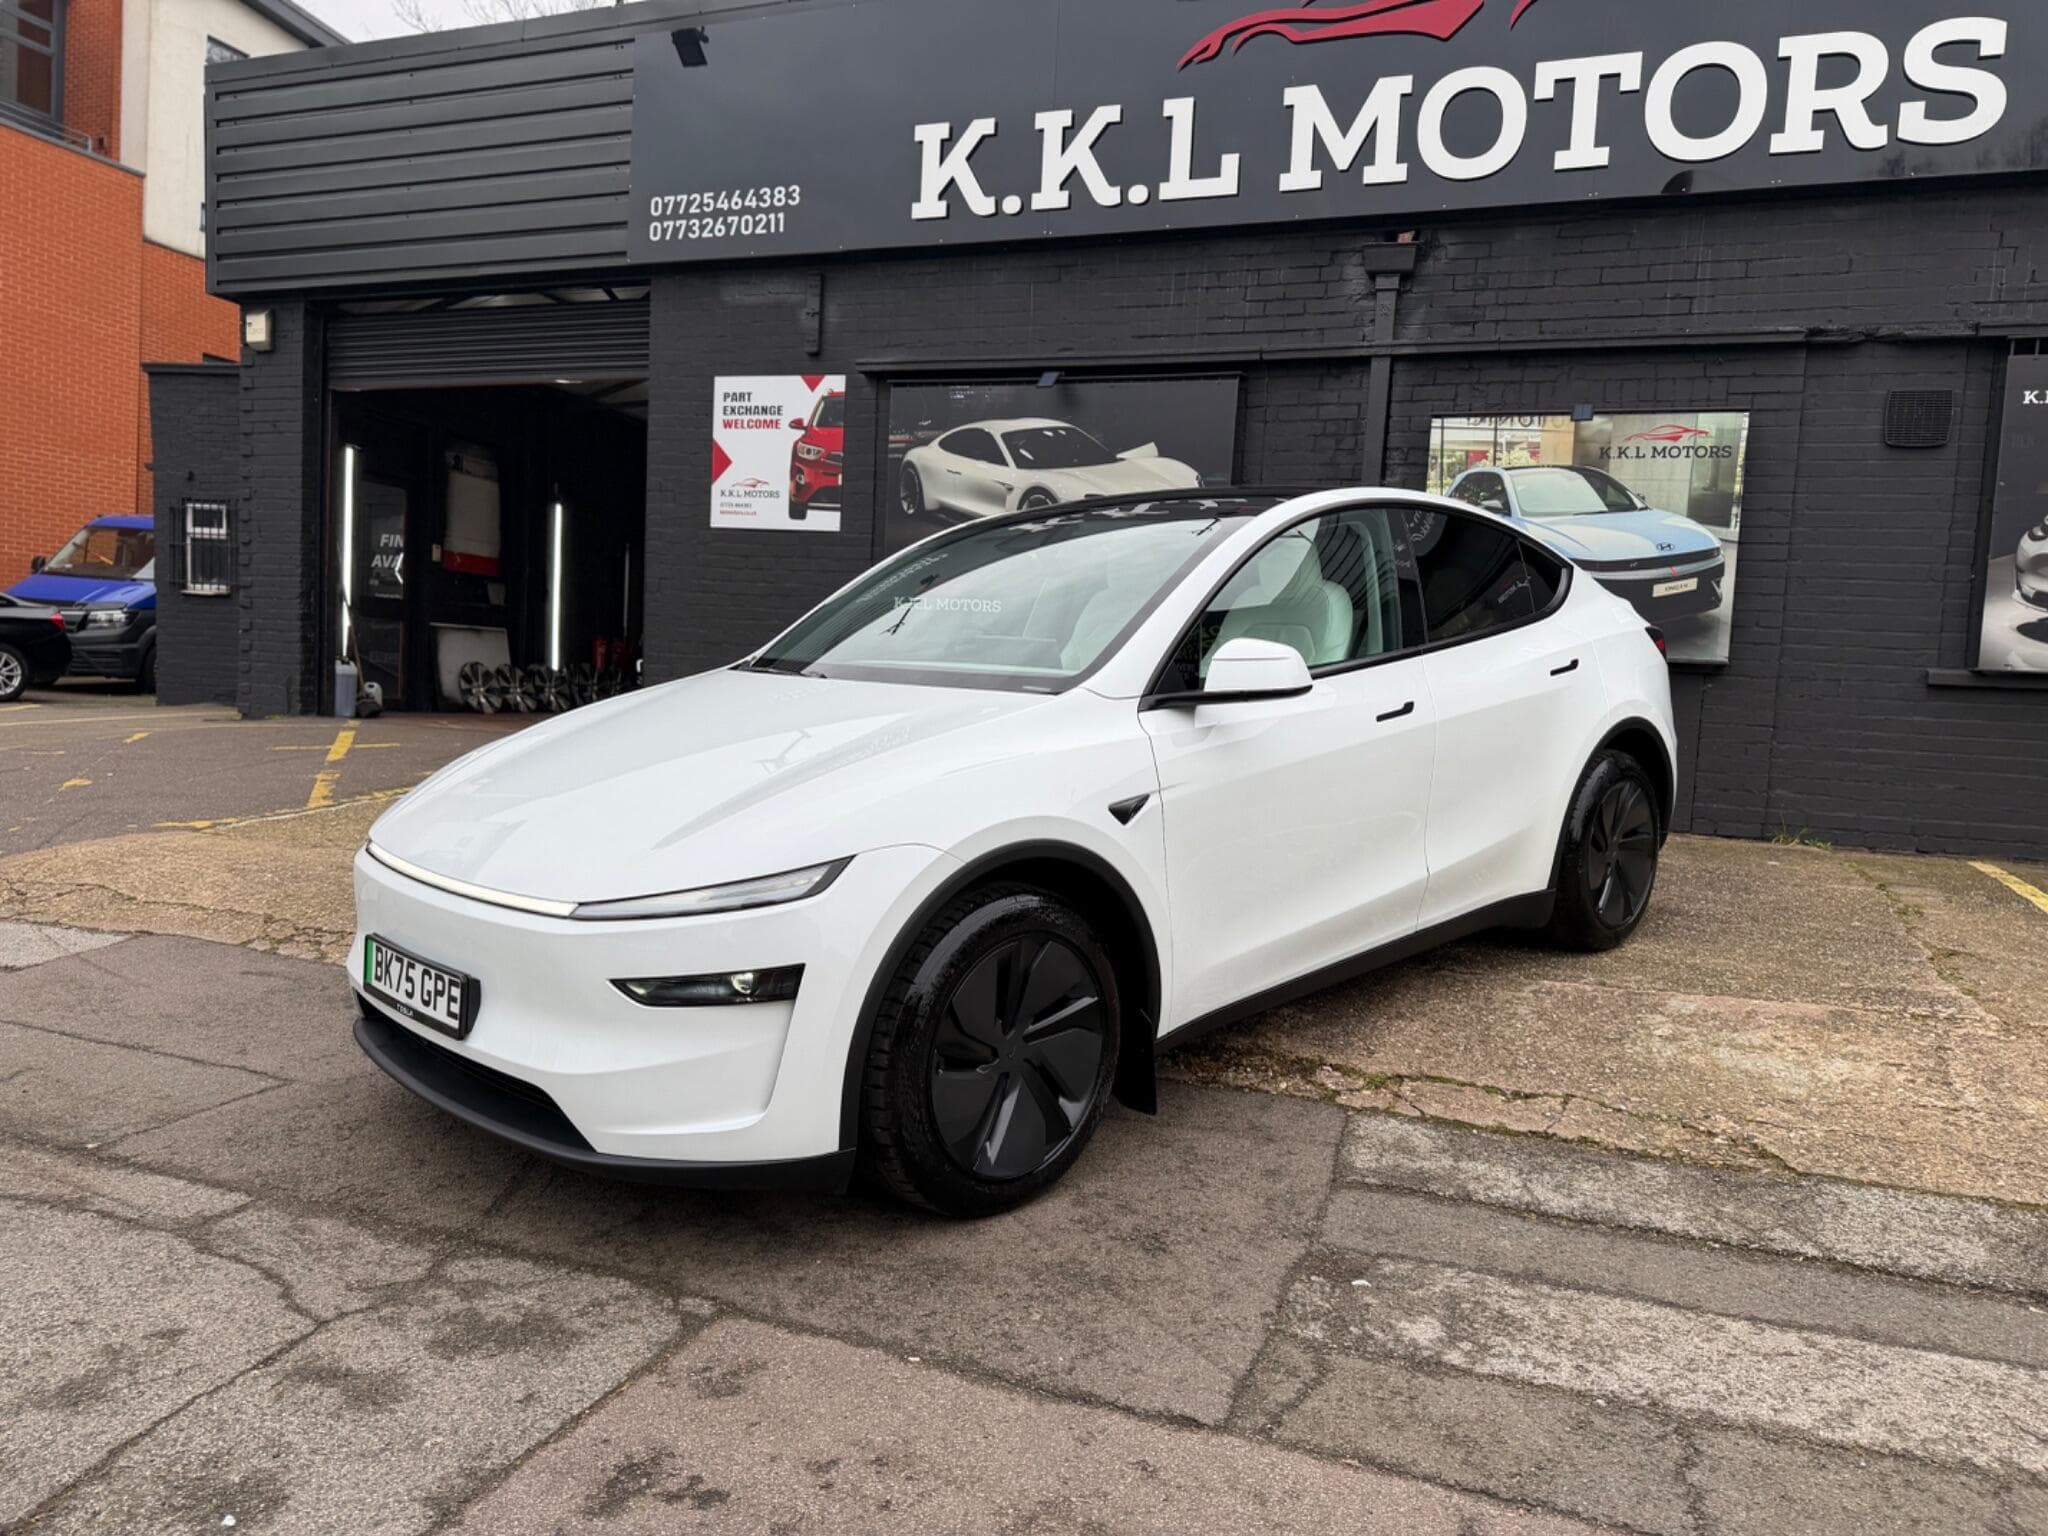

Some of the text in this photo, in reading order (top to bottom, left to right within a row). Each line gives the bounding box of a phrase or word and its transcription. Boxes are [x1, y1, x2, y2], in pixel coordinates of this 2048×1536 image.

[911, 16, 2008, 221] K.K.L MOTORS
[650, 185, 801, 217] 07725464383
[649, 211, 785, 242] 07732670211
[723, 392, 753, 403] PART
[723, 405, 784, 416] EXCHANGE
[722, 418, 782, 430] WELCOME
[1599, 444, 1732, 460] K.K.L MOTORS
[743, 489, 781, 499] MOTORS
[936, 598, 1002, 613] MOTORS
[374, 944, 460, 1021] BK75 GPE
